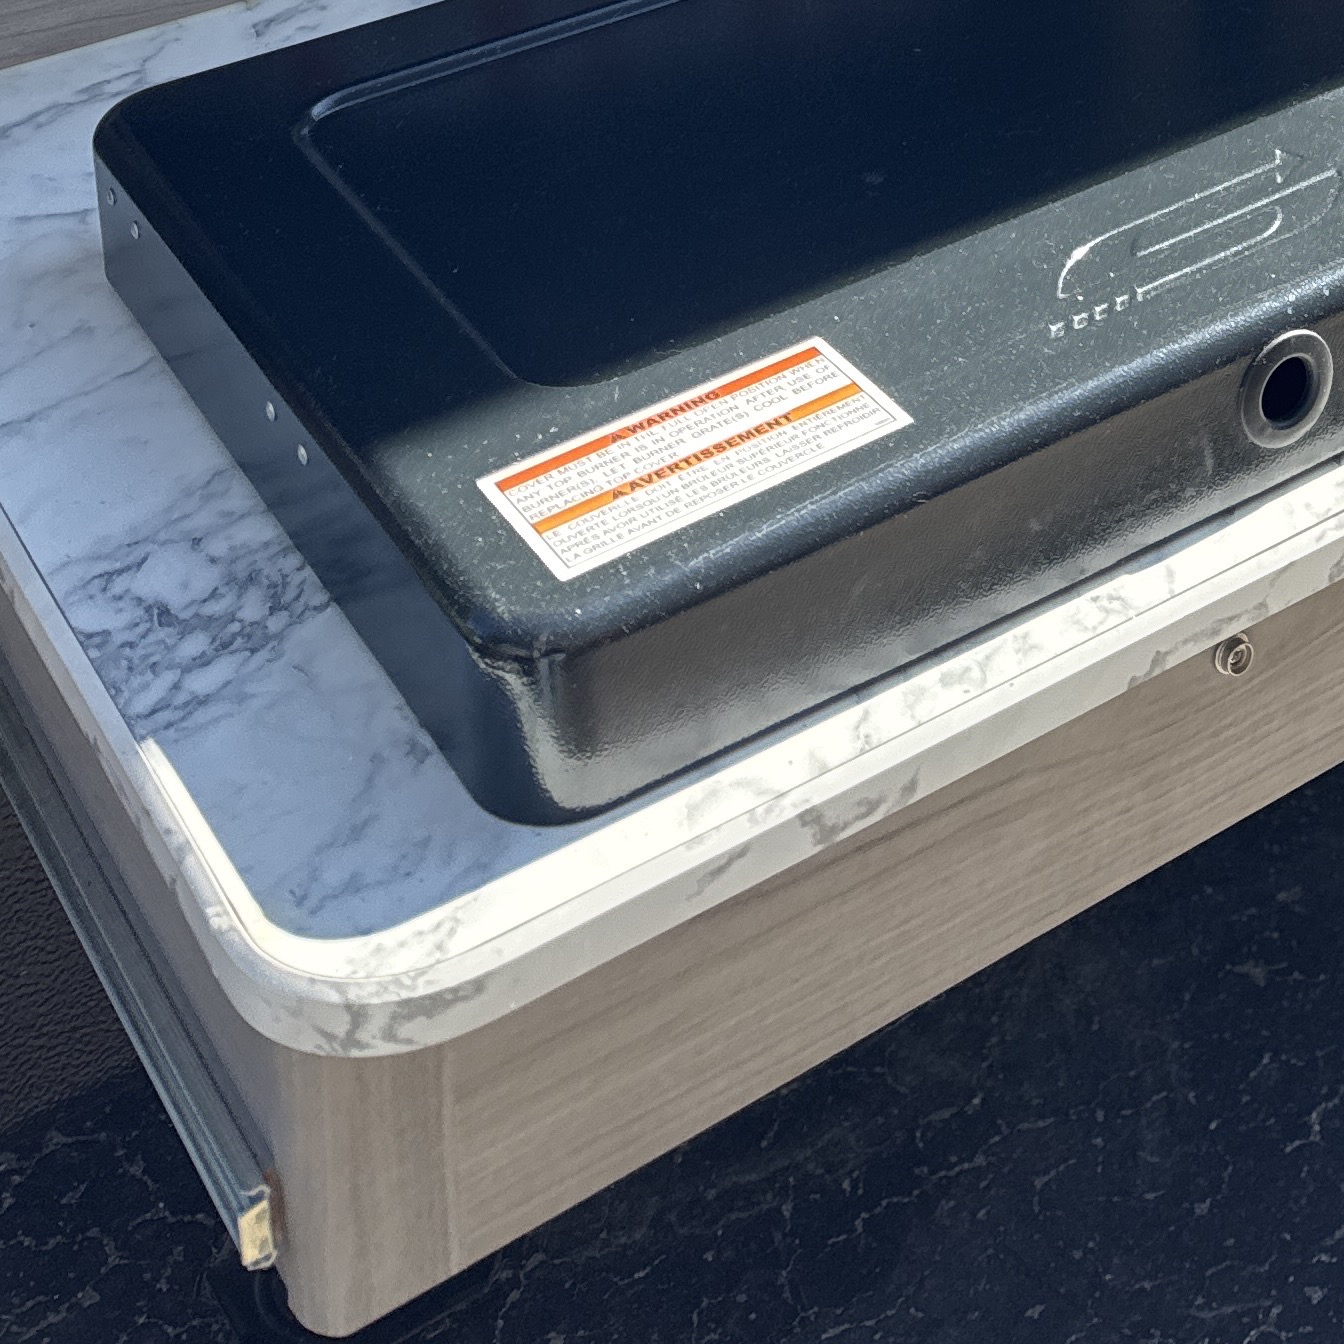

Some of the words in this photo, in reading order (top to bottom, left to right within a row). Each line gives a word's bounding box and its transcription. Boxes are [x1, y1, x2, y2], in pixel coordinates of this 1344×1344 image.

[508, 474, 555, 497] COVER
[558, 457, 594, 476] MUST
[597, 448, 614, 459] BE
[617, 441, 632, 450] IN
[694, 399, 729, 416] OPEN
[731, 374, 787, 400] POSITION
[789, 357, 826, 375] WHEN
[515, 490, 542, 505] ANY
[548, 476, 575, 491] TOP
[577, 451, 631, 478] BURNER
[635, 444, 649, 453] IS
[652, 436, 666, 445] IN
[669, 404, 740, 438] OPERATION
[788, 373, 812, 386] USE
[815, 364, 833, 374] OF
[603, 463, 628, 477] LET
[633, 438, 686, 464] BURNER
[691, 411, 750, 439] GRATE(S)
[753, 394, 788, 412] COOL
[792, 371, 840, 394] BEFORE
[626, 412, 796, 492] AVERTISSEMENT
[627, 390, 722, 434] WARNING
[530, 485, 605, 521] REPLACING
[607, 472, 634, 487] TOP
[634, 452, 680, 475] COVER
[566, 553, 582, 563] LA
[583, 533, 626, 555] GRILLE
[627, 515, 665, 535] AVANT
[666, 507, 682, 517] DE
[685, 481, 740, 509] REPOSER
[741, 474, 756, 483] LE
[758, 443, 825, 476] COUVERCLE
[602, 516, 638, 536] AVOIR
[686, 485, 709, 498] LES
[823, 407, 881, 436] REFROIDIR
[553, 519, 609, 548] OUVERTE
